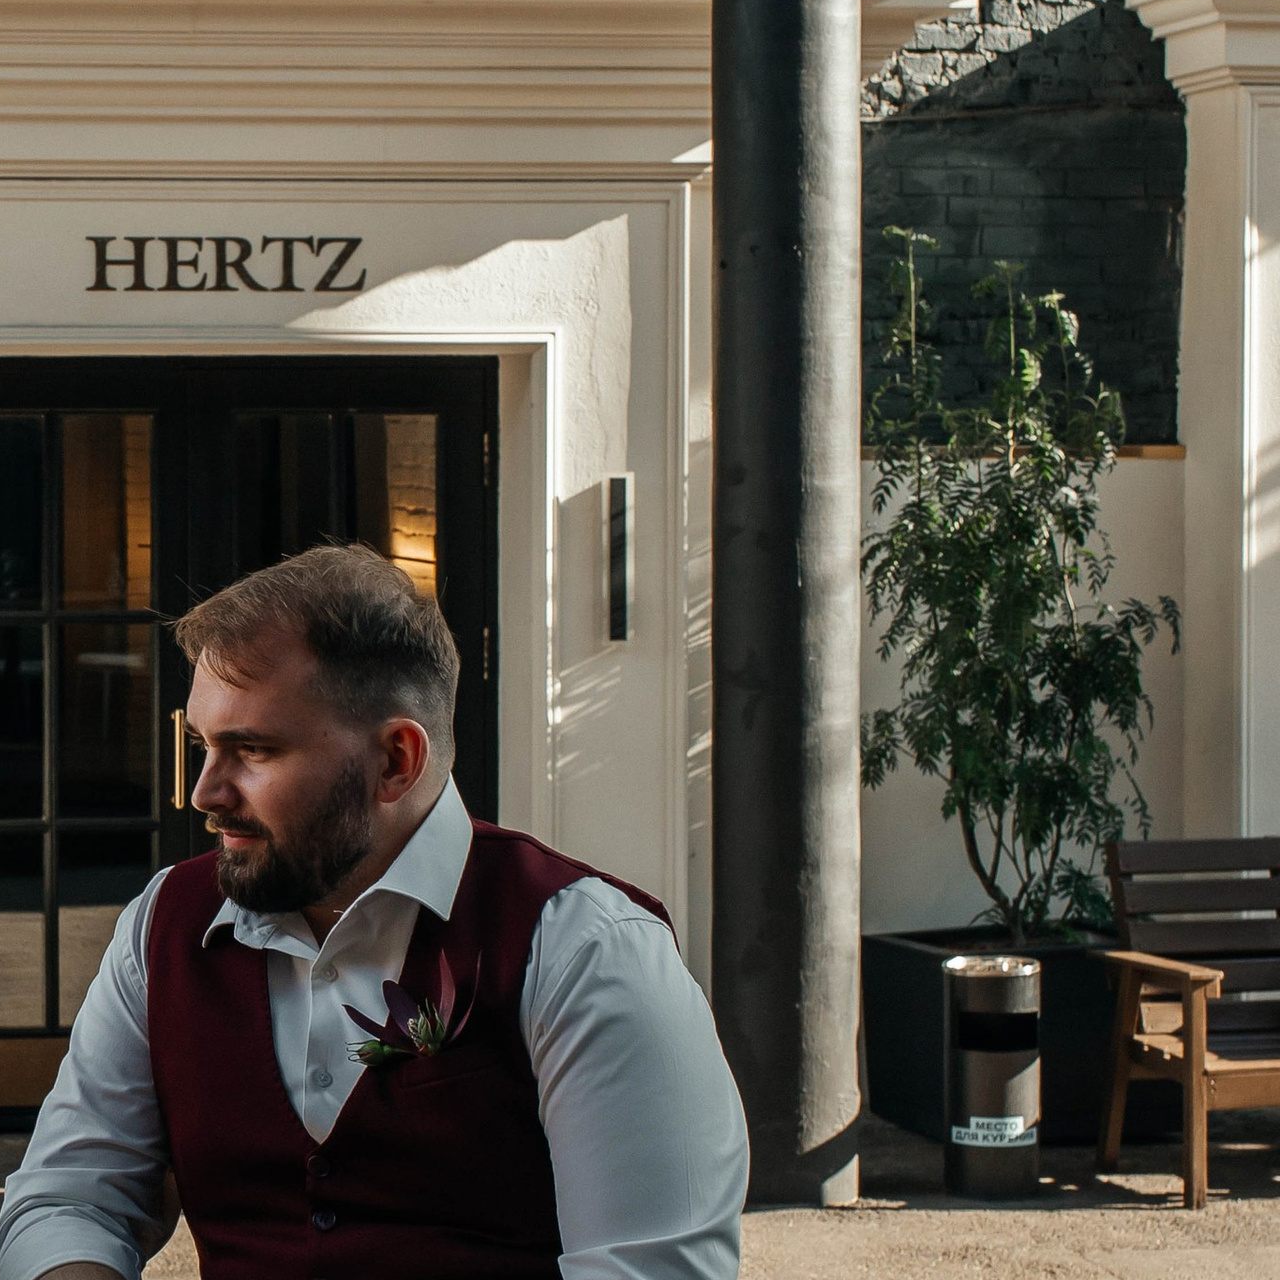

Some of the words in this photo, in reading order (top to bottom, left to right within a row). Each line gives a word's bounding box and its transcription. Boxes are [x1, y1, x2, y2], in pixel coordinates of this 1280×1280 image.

[85, 235, 367, 292] HERTZ
[975, 1121, 1018, 1132] МЕСТО
[954, 1130, 978, 1141] ДЛЯ
